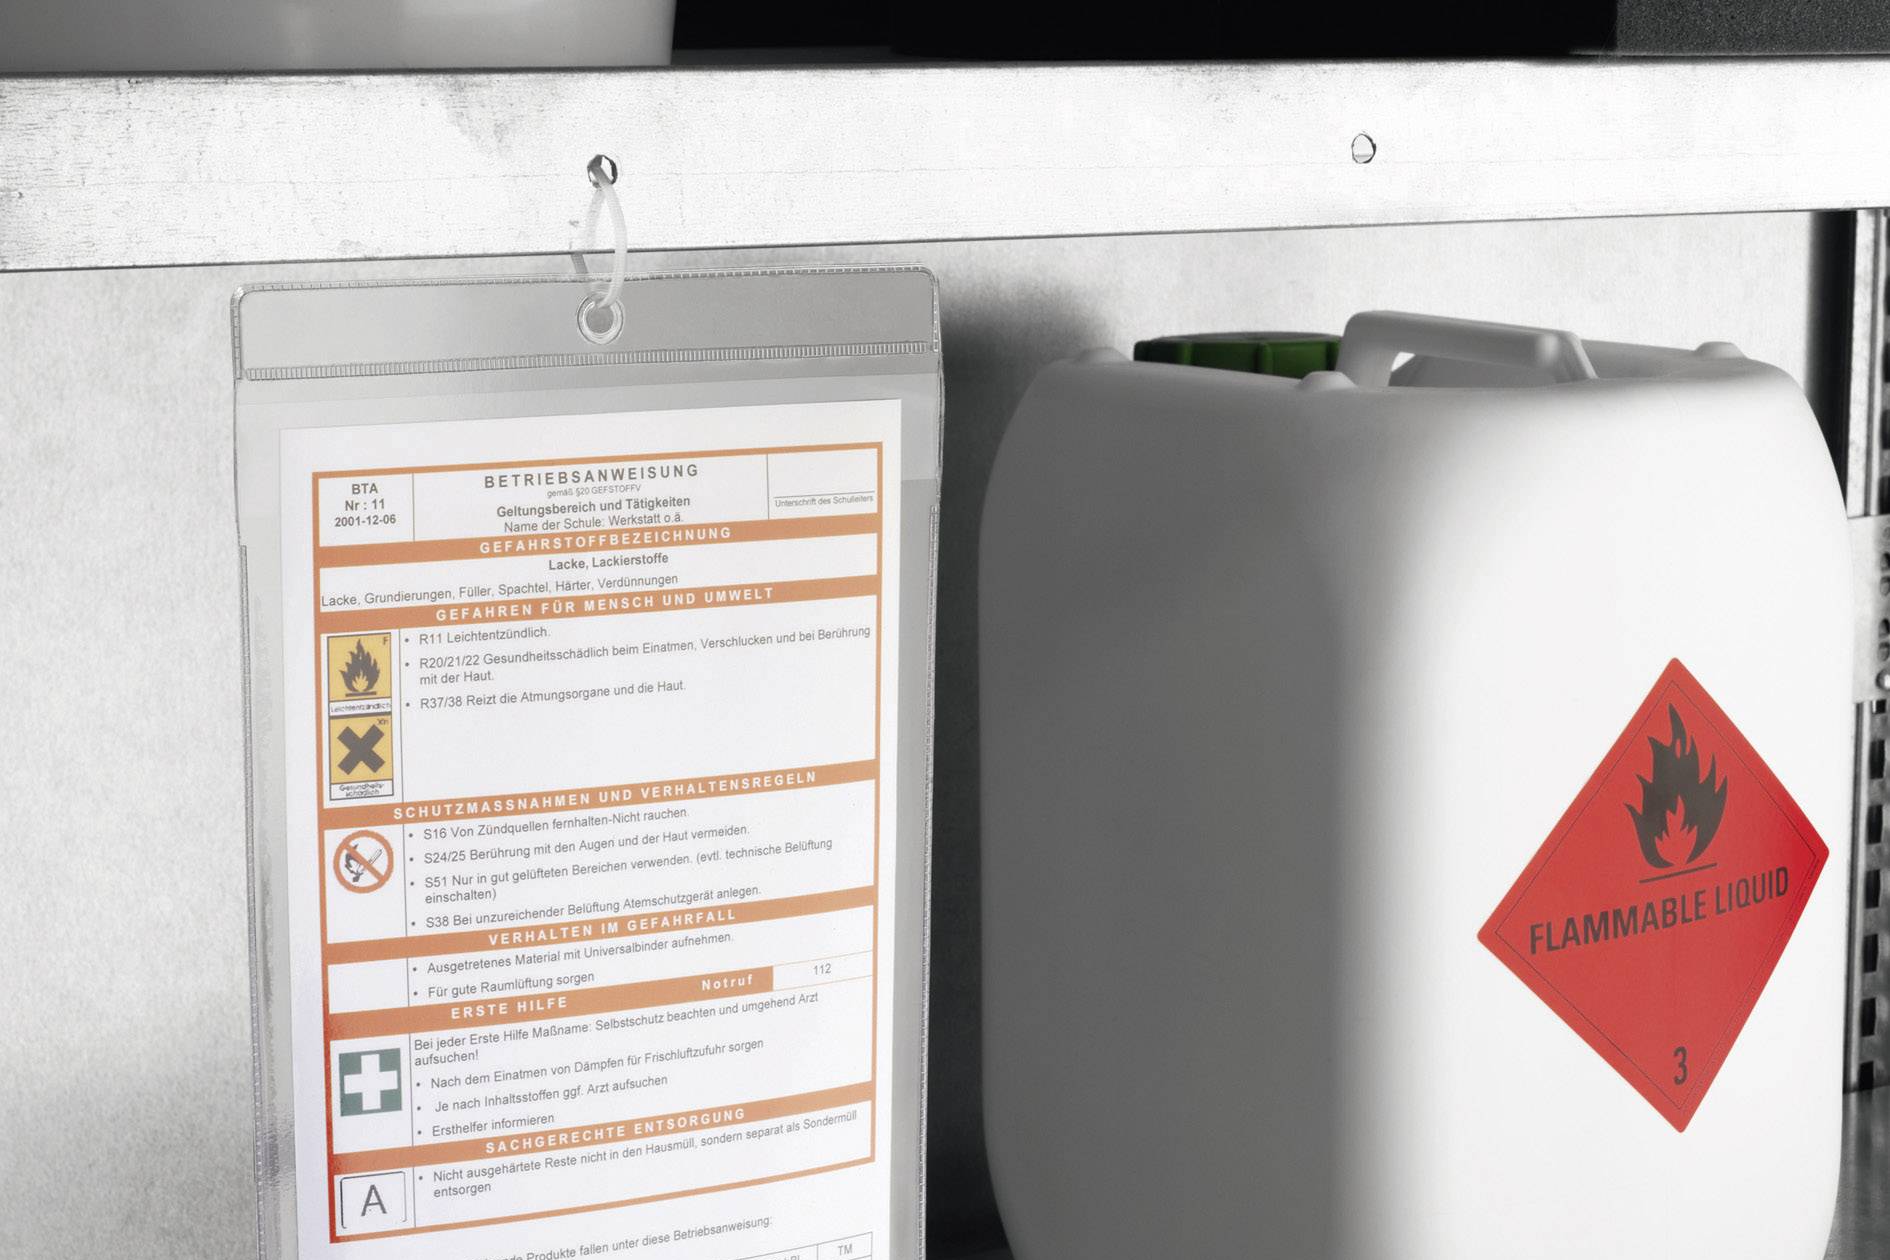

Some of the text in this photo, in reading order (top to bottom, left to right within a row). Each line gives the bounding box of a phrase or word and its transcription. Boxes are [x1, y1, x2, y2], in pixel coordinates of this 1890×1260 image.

[352, 483, 378, 495] BTA
[484, 463, 698, 489] BETRIEBSANWEISUNG
[372, 499, 385, 510] 11
[497, 496, 690, 521] Geltungsbereich und Tätigkeiten
[334, 514, 397, 528] 2001-12-06
[504, 513, 661, 533] Name der Werkstatt
[480, 527, 731, 553] GEFAHRSTOFFBEZEICHNUNG
[549, 553, 669, 571] Lacke, Lackierstoffe
[498, 574, 678, 597] Spachtel, Verdünnungen
[436, 587, 773, 622] GEFAHREN FÜR MENSCH UND UMWELT
[420, 626, 550, 645] R11 Leichtentzündlich.
[420, 626, 870, 669] R20/21/22 Gesundheitsschädlich beim Einatmen, Verschlucken und bei Berührung
[420, 670, 494, 685] mit der Haut.
[420, 680, 686, 709] R37/38 Reizt die Atmungsorgane und die Haut.
[394, 771, 816, 820] SCHUTZMASSNAHMEN UND VERHALTENSREGELN
[424, 807, 689, 840] S16 Von Zündquellen rauchen.
[424, 825, 750, 864] S24/25 Berührung mit den Augen und der Haut vermeiden.
[425, 838, 832, 889] S51 Nur in gut gelüfteten Bereichen verwenden. (evtl. technische Belüftung
[425, 890, 497, 904] einschalten)
[426, 885, 761, 928] S38 Bei unzureichender Belüftung Atemschutzgerät anlegen.
[1530, 866, 1789, 955] FLAMMABLE LIQUID
[488, 909, 736, 945] VERHALTEN IM GEFAHRFALL
[427, 932, 733, 974] Ausgetretenes Material mit Universalbinder aufnehmen.
[813, 963, 831, 975] 112
[428, 972, 595, 998] Für gute Raumlüftung sorgen
[702, 974, 753, 991] Notruf
[414, 992, 818, 1050] Bei jeder Erste Hilfe Maßname: Selbstschutz beachten und umgehend Arzt
[451, 997, 567, 1019] ERSTE HILFE
[414, 1050, 478, 1067] aufsuchen!
[431, 1039, 764, 1089] Nach dem Einatmen von Dämpfen für Frischluftzufuhr sorgen
[1674, 1046, 1688, 1085] 3
[435, 1075, 668, 1113] Je nach Inhaltsstoffen ggf. Arzt aufsuchen
[432, 1113, 555, 1137] Ersthelfer informieren
[486, 1108, 745, 1154] SACHGERECHTE ENTSORGUNG
[434, 1110, 857, 1182] Nicht ausgehärtete Reste nicht in den Hausmüll, sondern separat als Sondermüll
[361, 1184, 387, 1217] A
[434, 1182, 491, 1199] entsorgen
[579, 1242, 609, 1256] fallen
[612, 1239, 639, 1252] unter
[642, 1233, 670, 1246] diese
[674, 1216, 772, 1241] Betriebsanweisung:
[837, 1244, 853, 1256] TM
